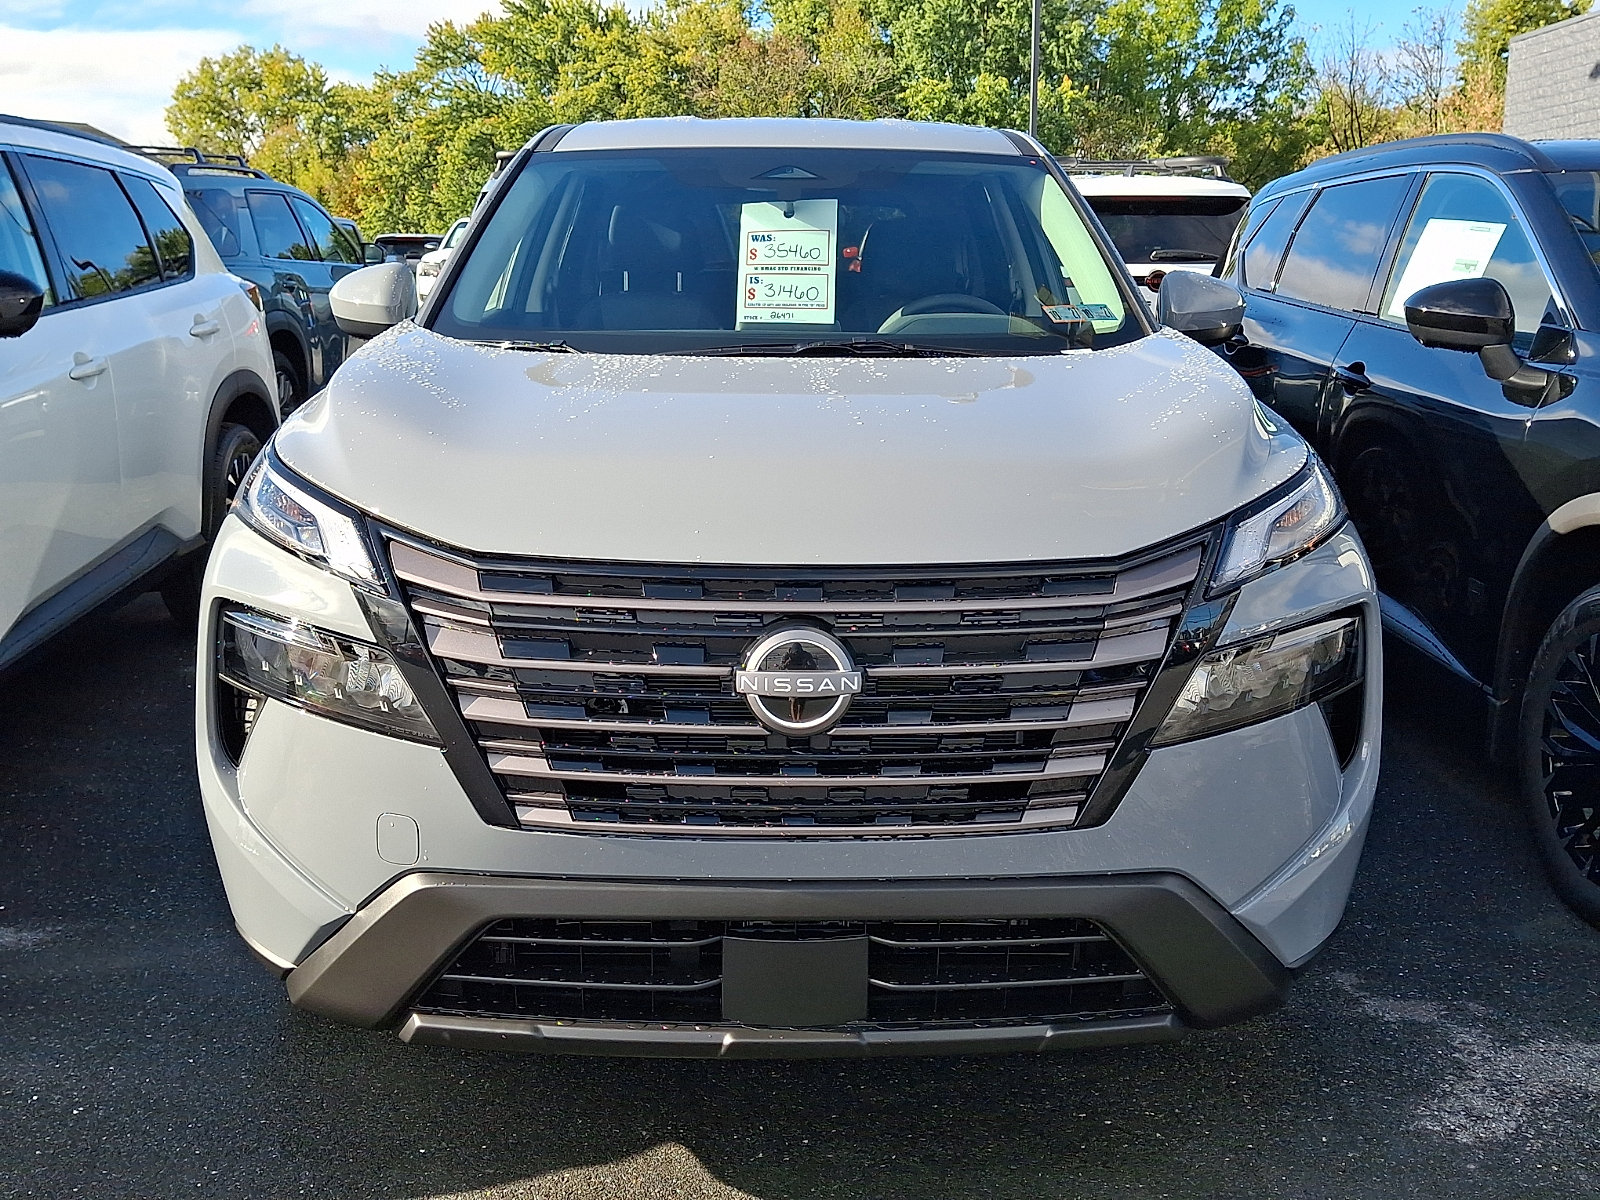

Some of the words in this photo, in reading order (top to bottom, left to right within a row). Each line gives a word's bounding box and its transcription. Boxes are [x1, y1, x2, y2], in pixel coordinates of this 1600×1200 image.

[751, 234, 776, 242] WAS:
[749, 248, 758, 260] $
[763, 242, 821, 260] 35460
[749, 276, 763, 284] IS:
[747, 287, 756, 300] $
[763, 283, 820, 301] 31460
[740, 676, 859, 693] NISSAN
